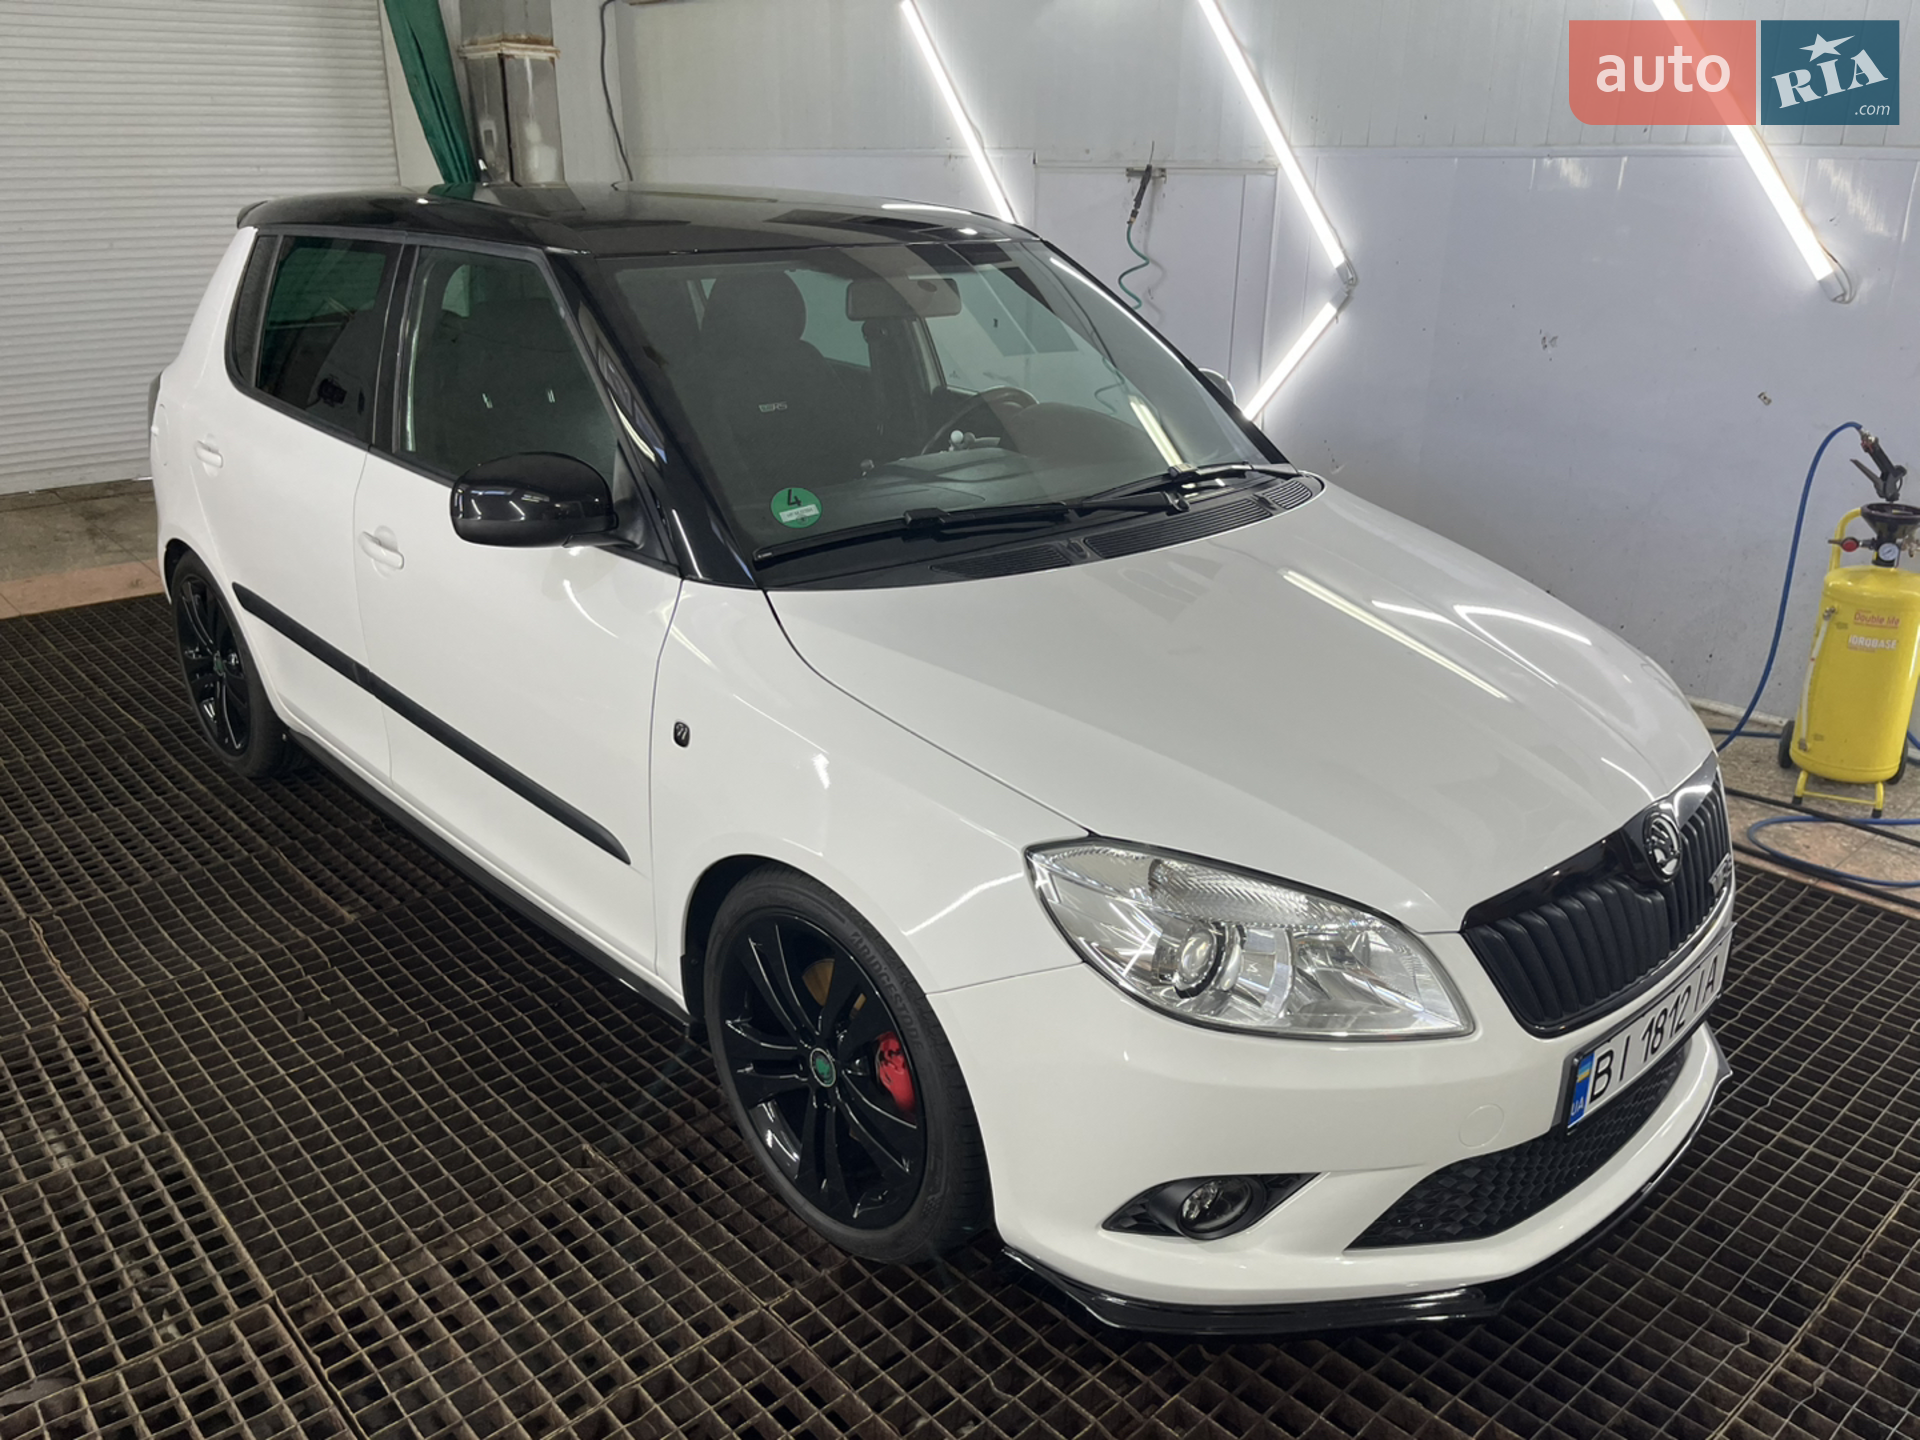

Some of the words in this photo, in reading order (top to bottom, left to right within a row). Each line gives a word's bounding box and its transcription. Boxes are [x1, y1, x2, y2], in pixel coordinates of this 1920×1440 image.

[787, 489, 802, 507] 4
[1854, 612, 1885, 625] Double
[1589, 1035, 1631, 1103] BI
[1641, 985, 1691, 1063] 1812
[1694, 955, 1718, 1012] IA
[1570, 1096, 1584, 1117] UA
